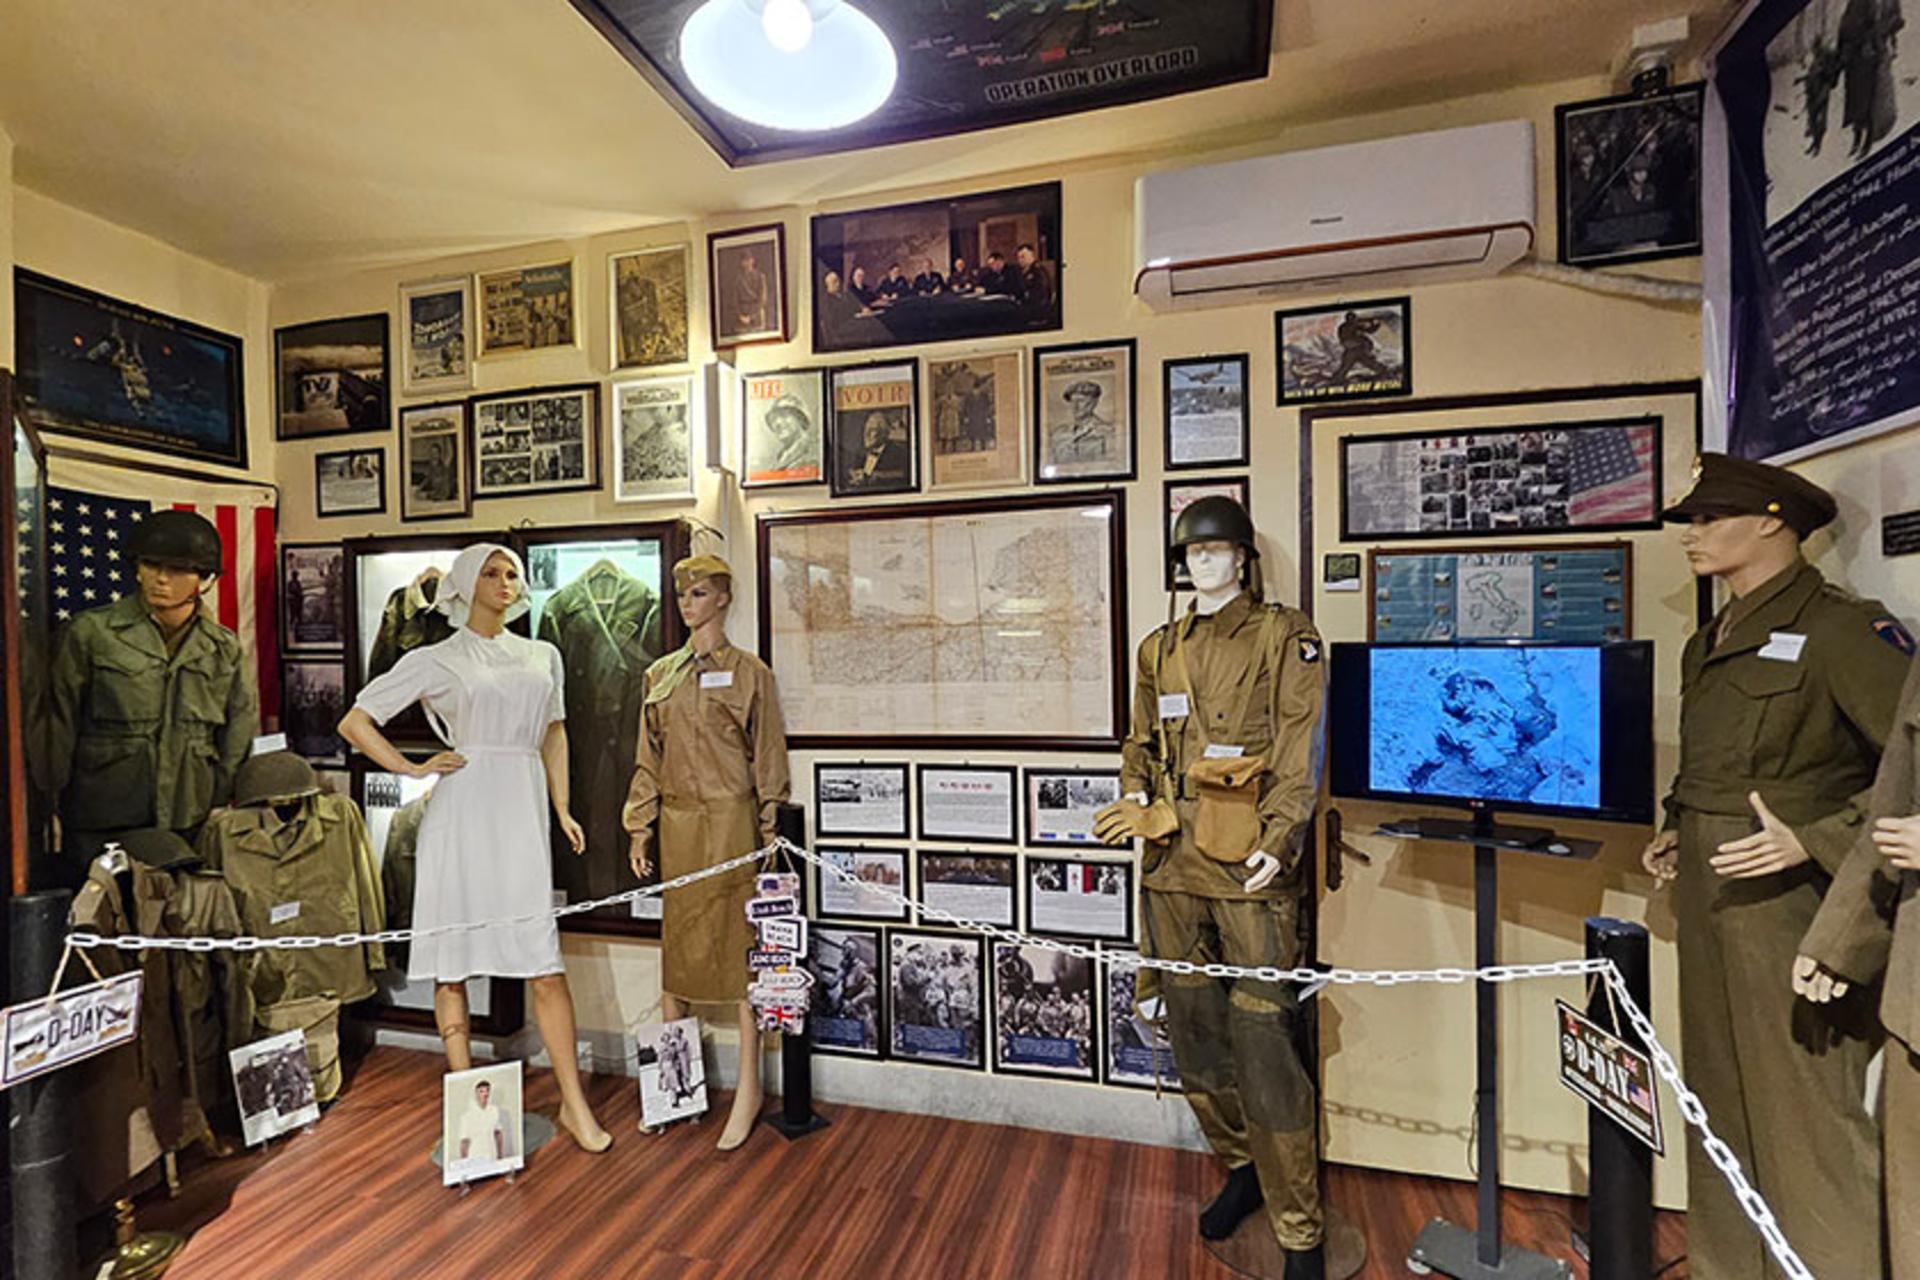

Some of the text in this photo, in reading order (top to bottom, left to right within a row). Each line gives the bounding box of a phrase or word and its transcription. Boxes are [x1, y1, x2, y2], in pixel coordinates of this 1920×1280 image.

[985, 46, 1197, 102] OPERATION OVERLORD
[843, 385, 904, 405] VOIR
[48, 1004, 105, 1050] D-DAY
[1576, 1037, 1631, 1104] D-DAY
